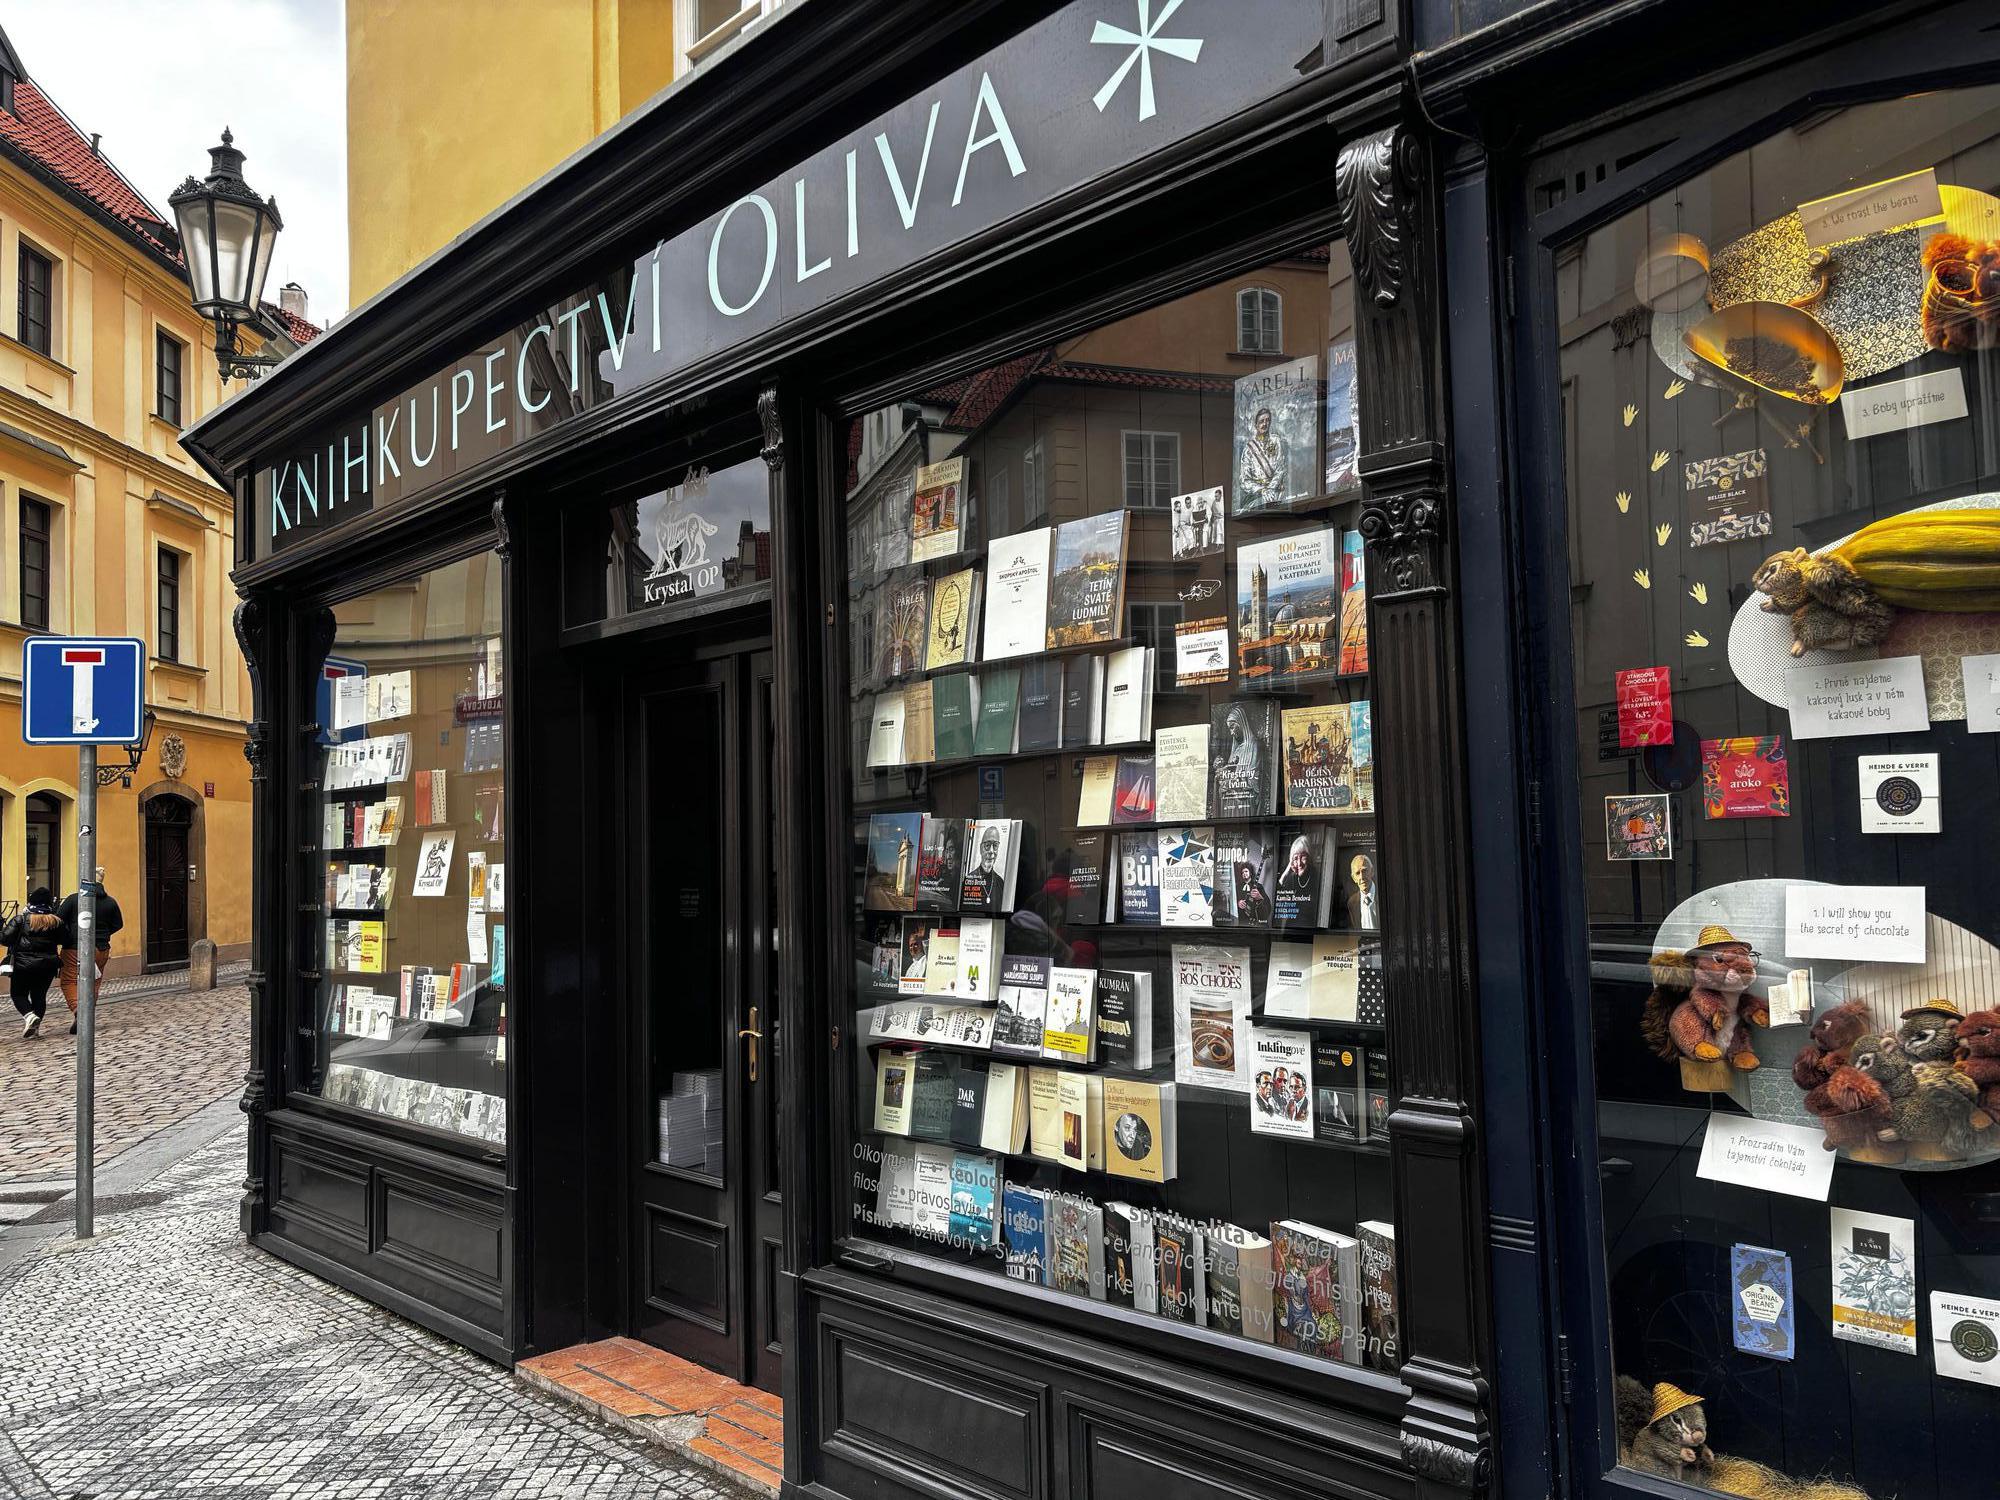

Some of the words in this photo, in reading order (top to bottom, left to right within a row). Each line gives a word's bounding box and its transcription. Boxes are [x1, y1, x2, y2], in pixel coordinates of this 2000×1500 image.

[1846, 205, 1870, 221] roast
[1872, 200, 1888, 214] the
[1890, 194, 1919, 209] beans
[271, 239, 665, 538] KNIHKUPECTVÍ
[707, 71, 1027, 317] OLIVA
[1239, 370, 1293, 401] KAREL
[1872, 402, 1897, 415] Boby
[1279, 541, 1296, 554] 100
[642, 573, 694, 605] Krystal
[697, 566, 720, 589] OP
[1072, 603, 1111, 620] LUDMILY
[1853, 673, 1893, 689] najdeme
[1806, 694, 1843, 709] kakaový
[1846, 692, 1864, 704] lusk
[1866, 693, 1873, 701] a
[1827, 708, 1864, 721] kakaové
[1867, 706, 1891, 721] boby
[1729, 778, 1762, 789] aroko
[1828, 907, 1845, 919] will
[1848, 907, 1871, 919] show
[1874, 909, 1892, 923] you
[1800, 922, 1814, 934] the
[1817, 924, 1844, 935] secret
[1847, 923, 1861, 938] of
[1864, 925, 1910, 937] chocolate
[1099, 976, 1130, 993] KUMRÁN
[1257, 1040, 1306, 1057] Inklingové
[957, 1087, 975, 1103] DAR
[1738, 1135, 1784, 1153] Prozradím
[1787, 1143, 1805, 1157] Vám
[853, 1202, 894, 1230] Písmo
[908, 1221, 977, 1256] rozhovory
[1129, 1205, 1246, 1246] spiritualita
[1744, 1290, 1779, 1303] ORIGINAL
[1750, 1298, 1775, 1309] BEANS
[1941, 1303, 1969, 1314] HEINDE
